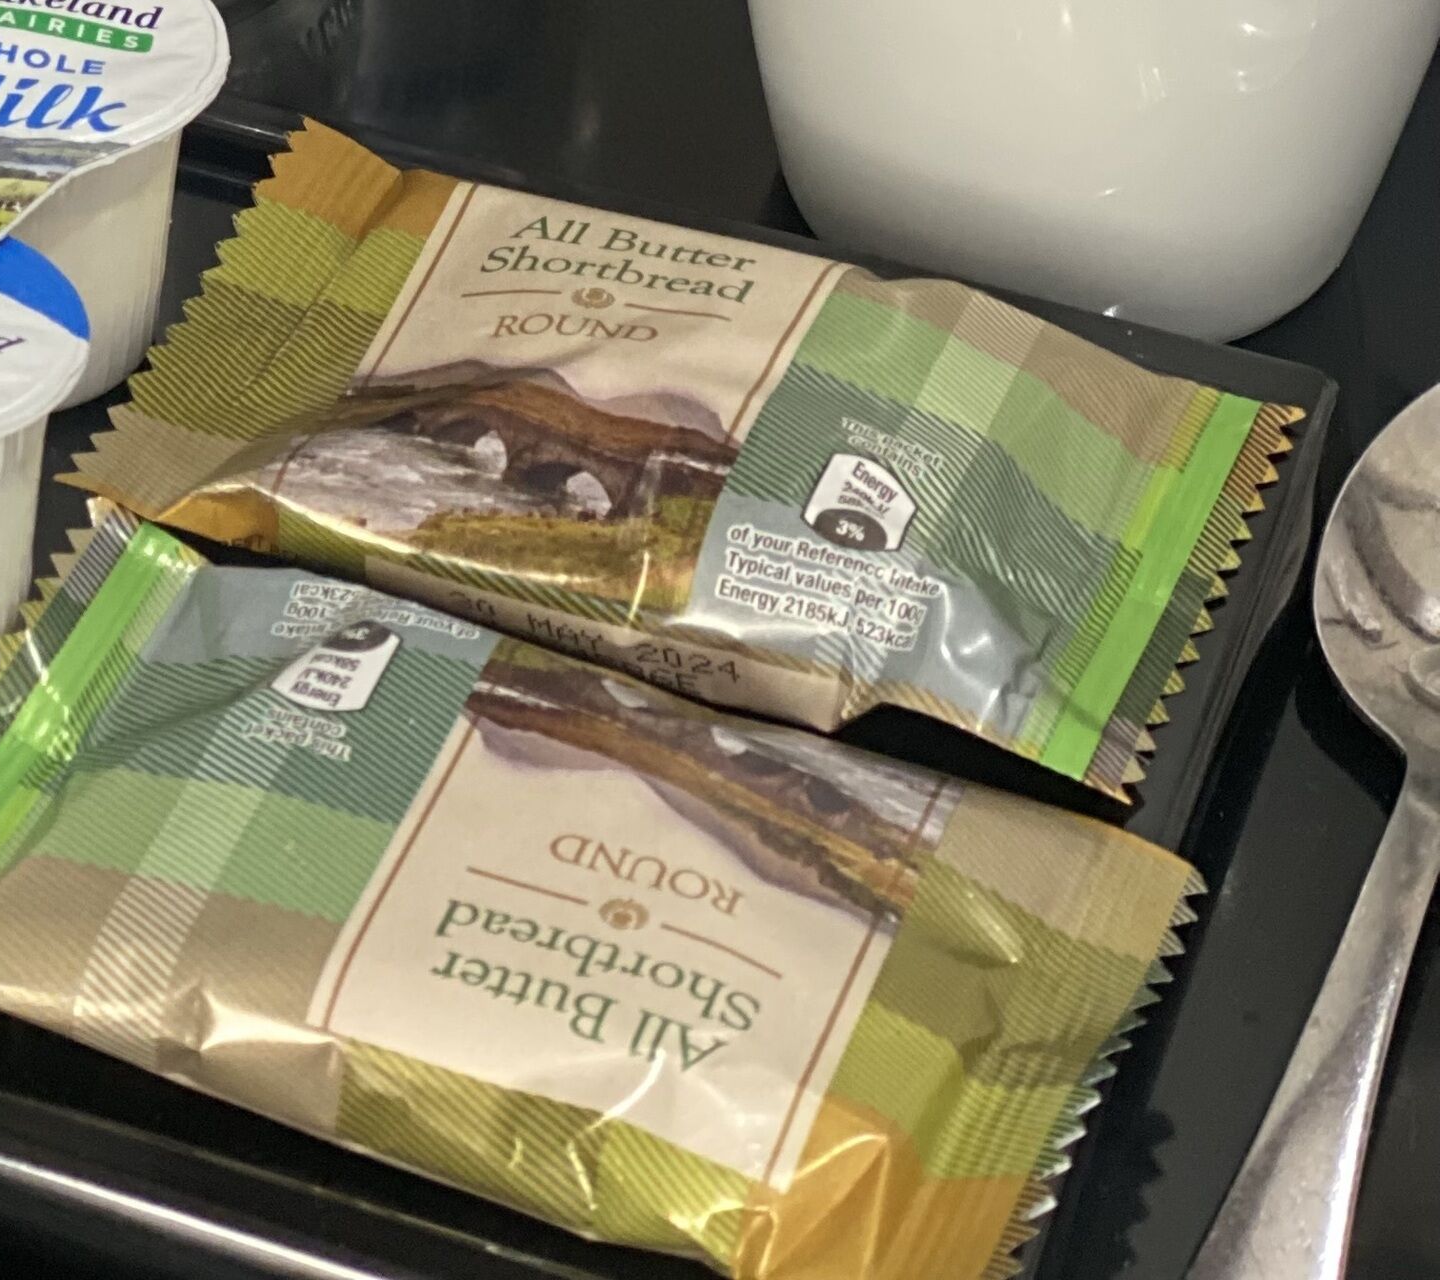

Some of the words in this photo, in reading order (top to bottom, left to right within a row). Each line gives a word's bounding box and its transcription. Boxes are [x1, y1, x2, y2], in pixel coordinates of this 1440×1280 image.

[509, 215, 592, 245] All
[598, 227, 758, 273] Butter
[480, 244, 756, 305] Shortbread
[492, 313, 660, 343] ROUND
[852, 460, 899, 503] Energy
[729, 527, 750, 543] of
[752, 533, 793, 555] your
[835, 519, 866, 542] 3%
[294, 583, 355, 602] 23kcal
[718, 579, 781, 612] Energy
[727, 551, 792, 582] Typical
[795, 572, 853, 599] values
[855, 589, 883, 612] per
[417, 615, 455, 634] your
[633, 641, 744, 685] 2024
[292, 681, 342, 708] Energy
[548, 832, 746, 918] ROUND
[434, 898, 762, 1032] Shortbread
[430, 950, 622, 1045] Butter
[628, 1008, 729, 1073] All
